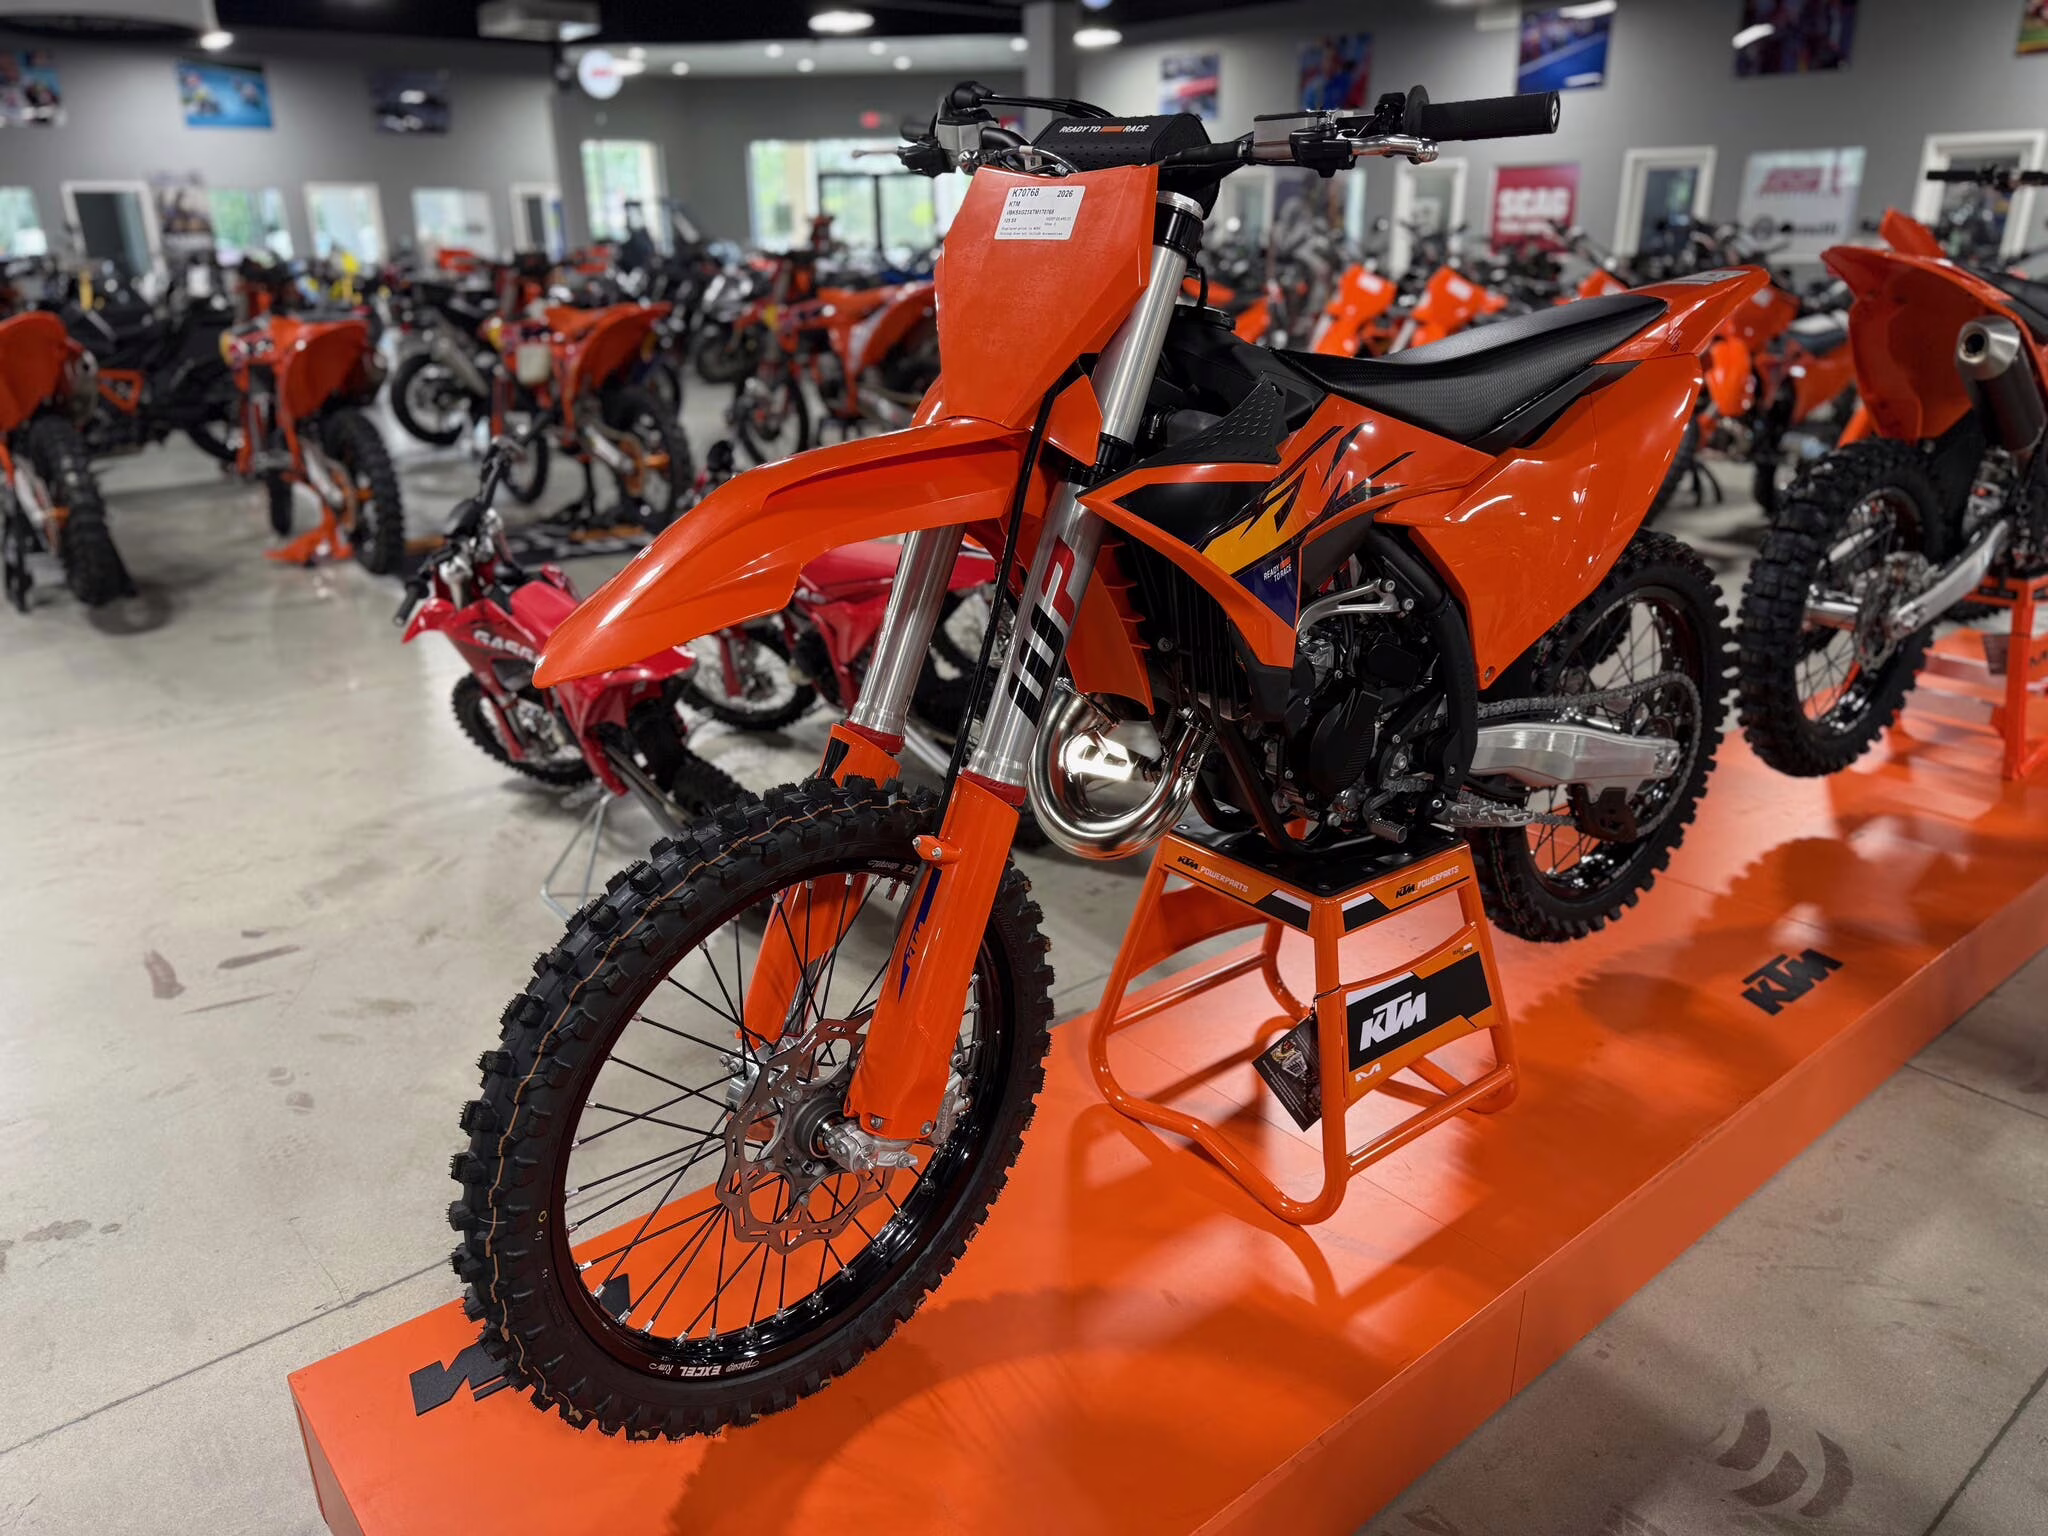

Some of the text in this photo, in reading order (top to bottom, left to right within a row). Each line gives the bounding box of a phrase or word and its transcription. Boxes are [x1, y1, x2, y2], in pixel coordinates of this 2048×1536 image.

[1060, 125, 1149, 133] READY TO RACE
[1012, 188, 1074, 198] K70768 2026
[1263, 563, 1280, 581] READY
[1273, 563, 1292, 582] TO RACE
[1177, 856, 1249, 893] KTM POWERPARTS
[1395, 865, 1460, 899] KTM POWERPARTS
[1740, 948, 1844, 1016] KTM
[1359, 991, 1427, 1052] KTM
[680, 1365, 722, 1377] EXCEL
